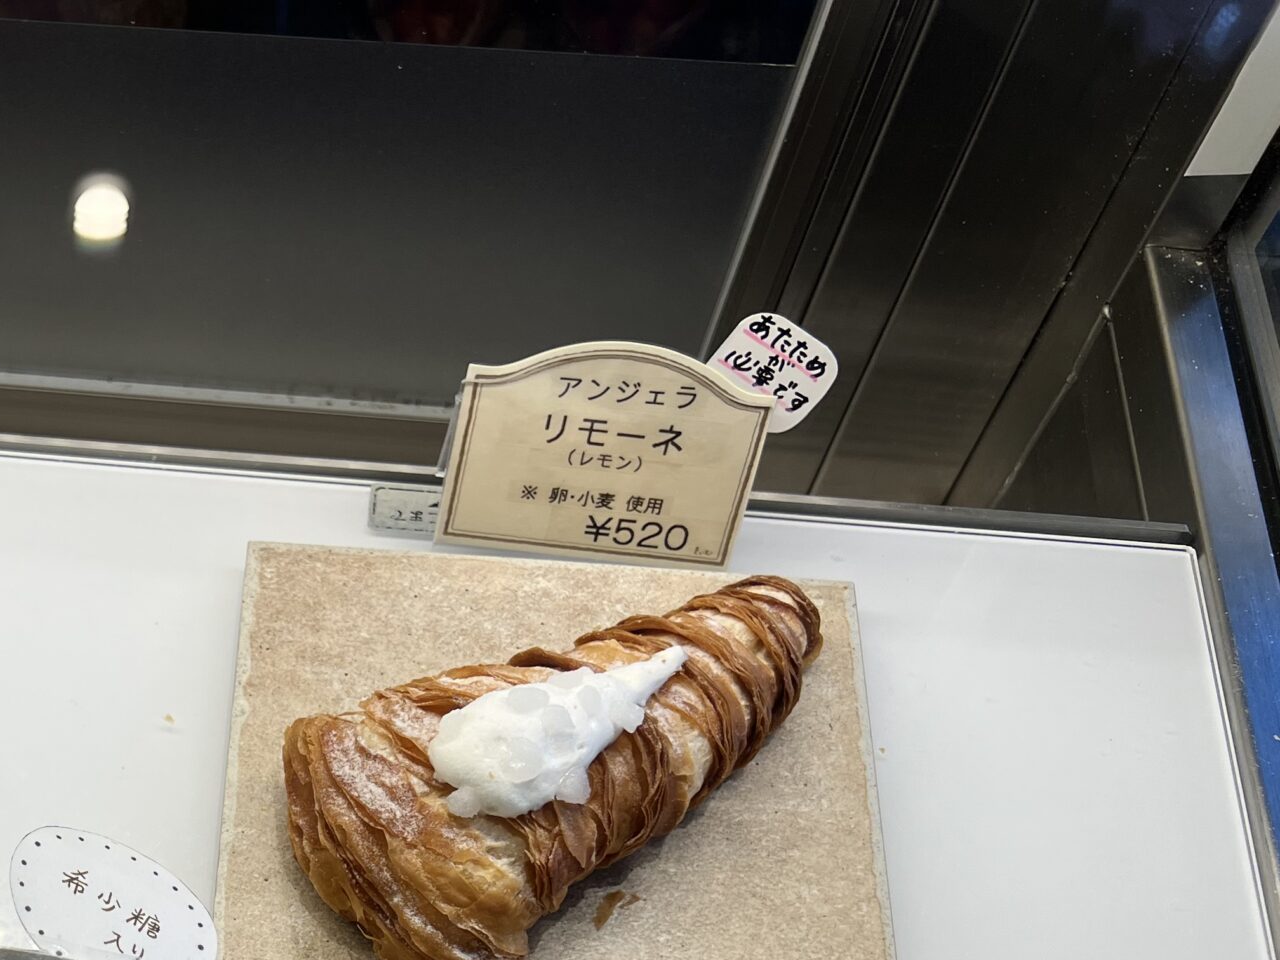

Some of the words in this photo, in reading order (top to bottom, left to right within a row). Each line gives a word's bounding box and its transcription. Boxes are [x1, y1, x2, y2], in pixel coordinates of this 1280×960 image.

[749, 314, 827, 379] あたため
[558, 376, 699, 409] アンジェラ
[724, 350, 809, 411] 必要です
[543, 413, 685, 457] リモーネ
[566, 448, 644, 473] （レモン）
[583, 515, 689, 551] ¥520
[61, 869, 161, 939] 希少糖
[103, 930, 145, 960] 入り
